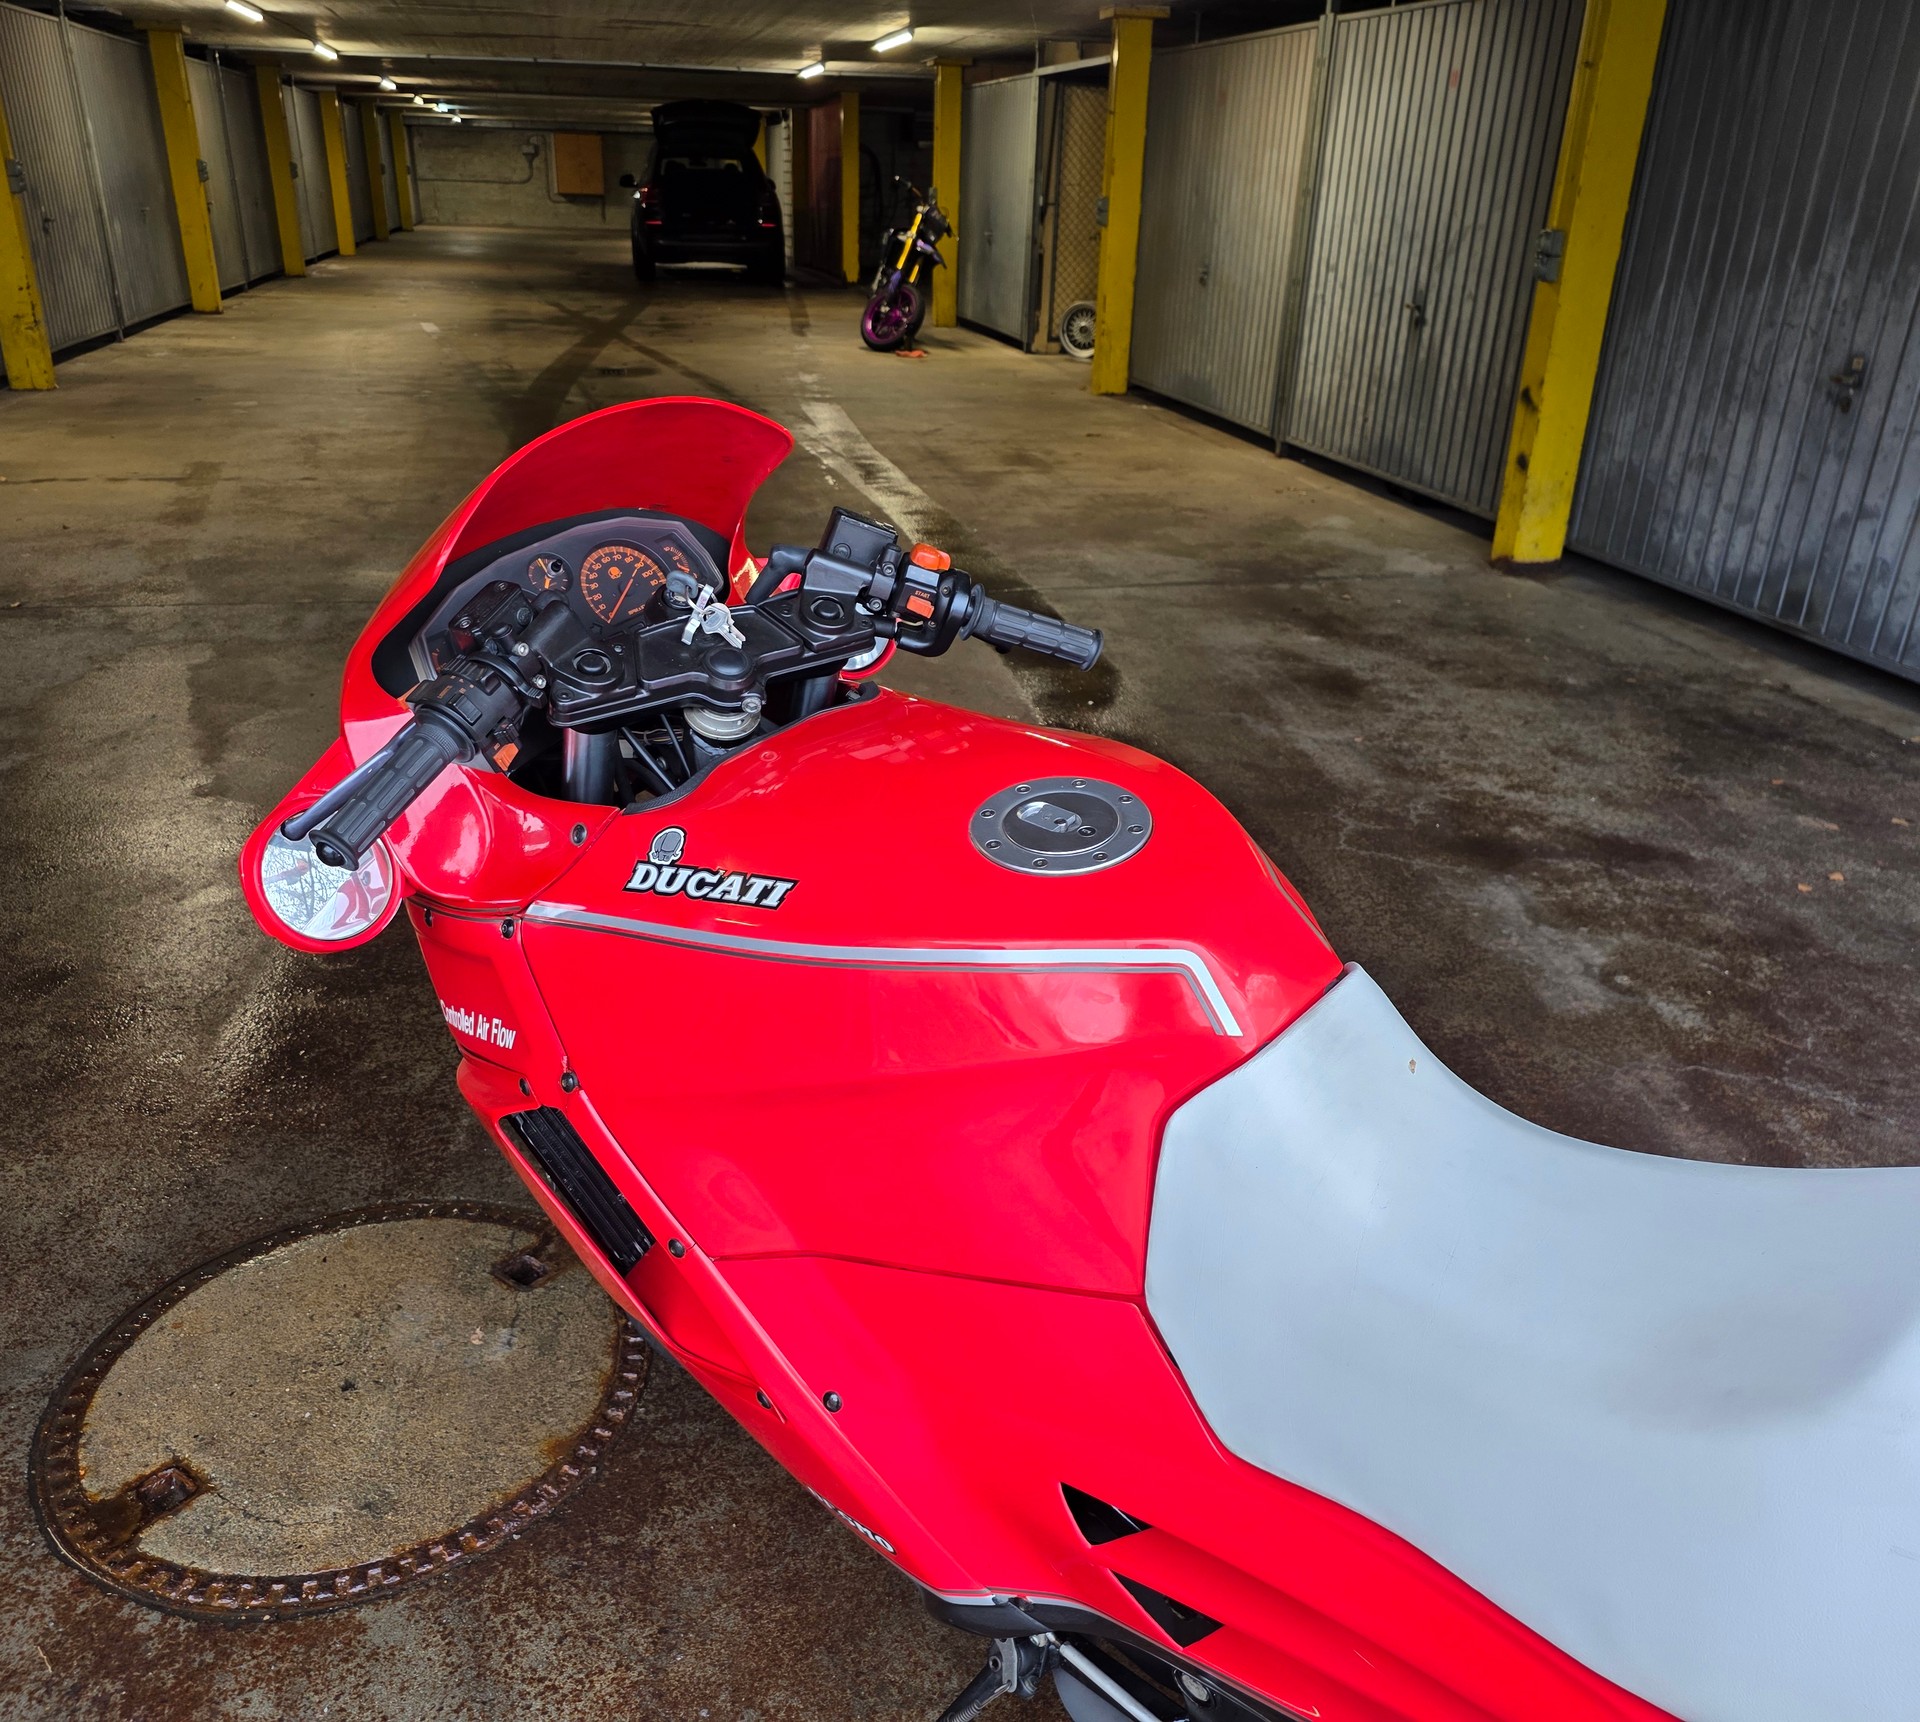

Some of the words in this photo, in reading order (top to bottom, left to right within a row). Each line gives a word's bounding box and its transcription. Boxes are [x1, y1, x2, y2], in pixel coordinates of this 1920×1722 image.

[914, 590, 930, 599] START
[625, 862, 795, 907] DUCATI
[440, 999, 474, 1035] Controlled
[476, 1013, 490, 1041] Air
[490, 1018, 516, 1049] Flow
